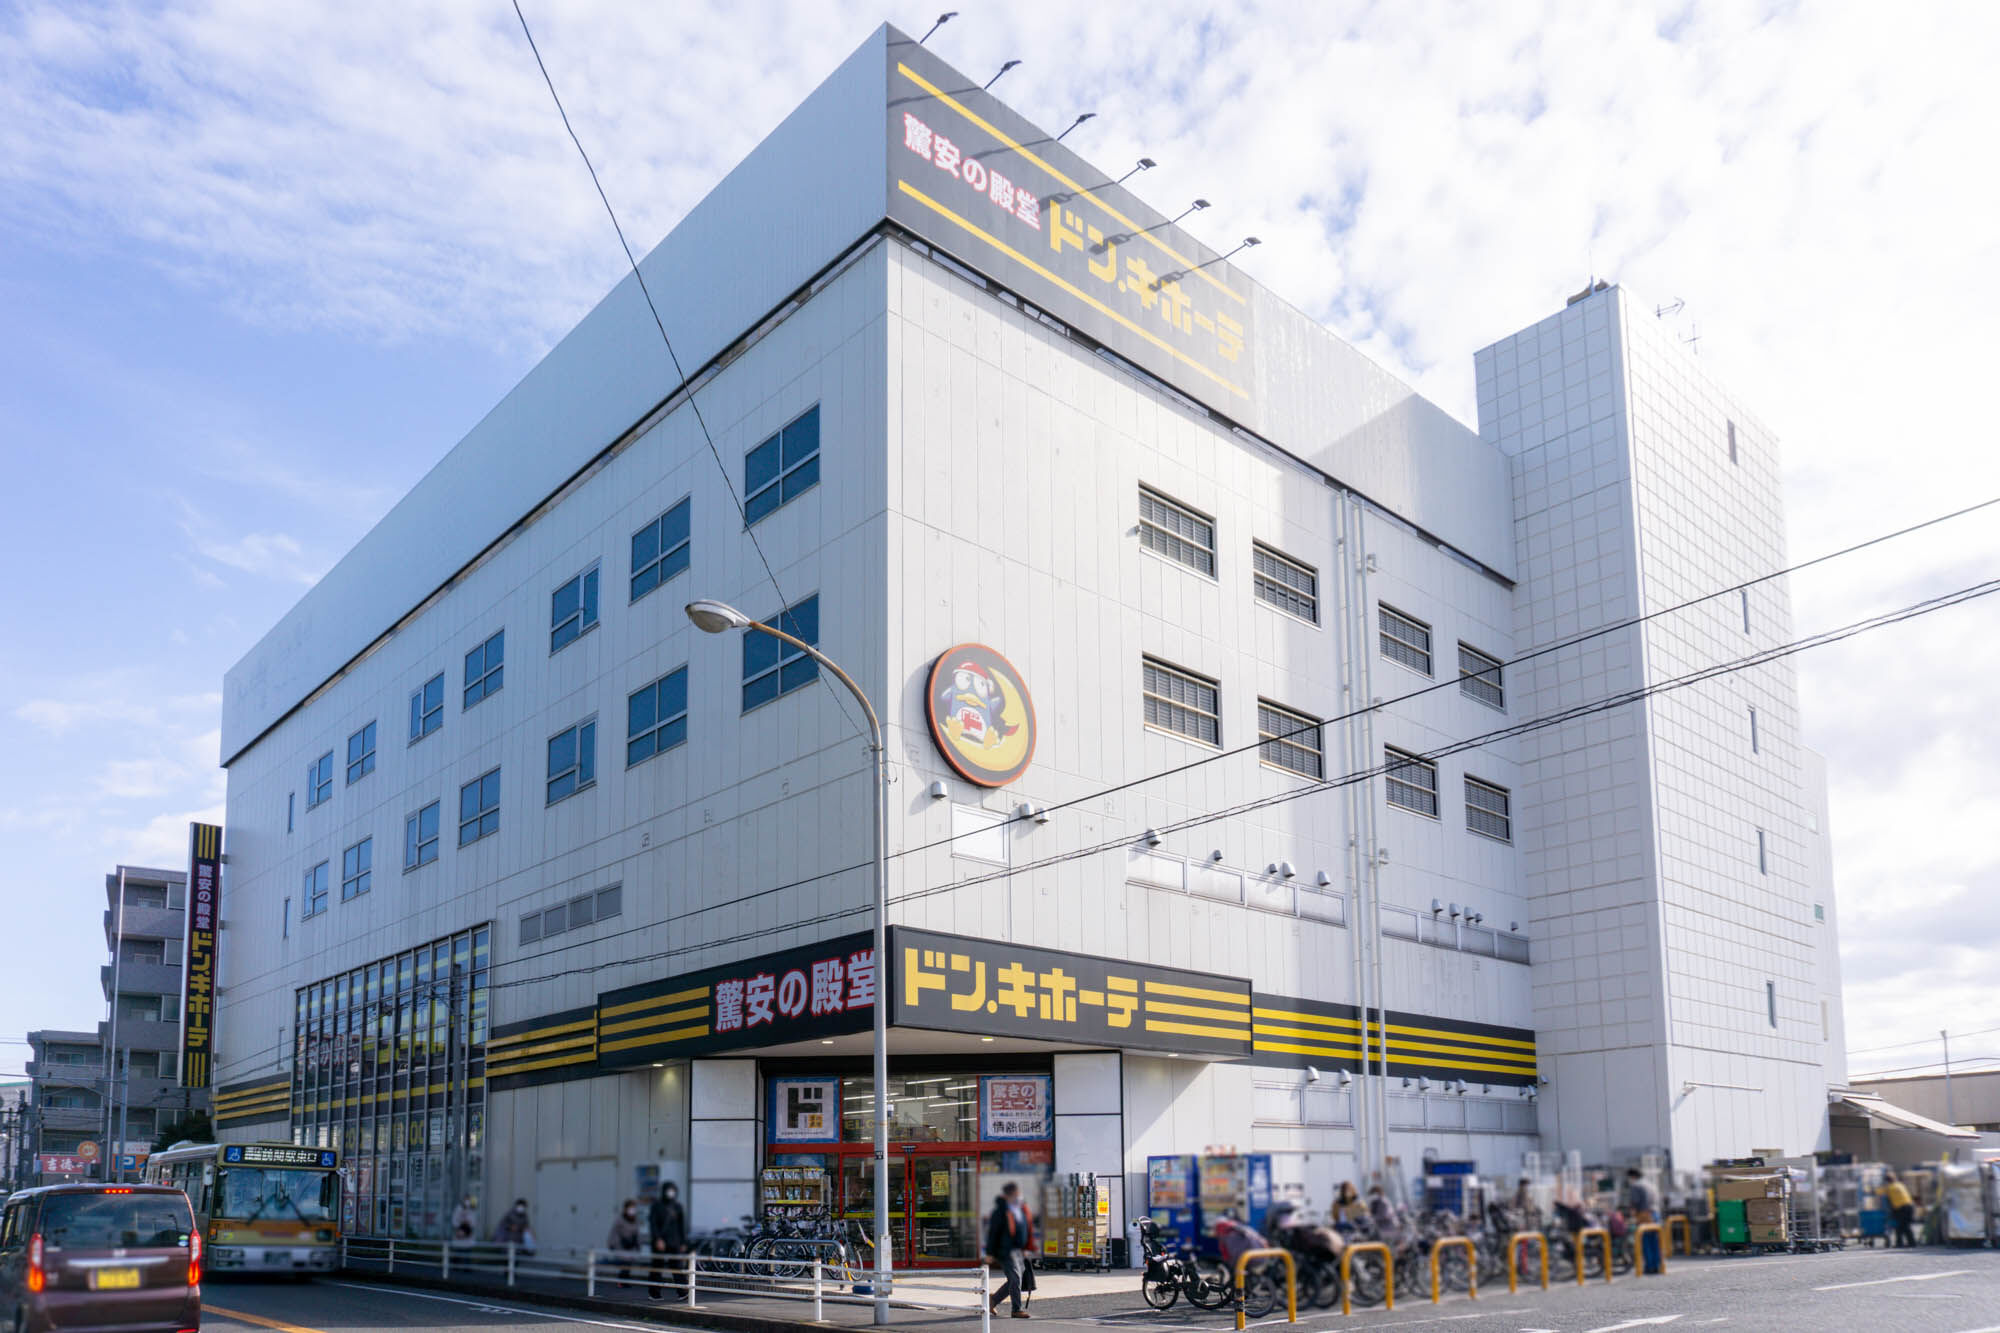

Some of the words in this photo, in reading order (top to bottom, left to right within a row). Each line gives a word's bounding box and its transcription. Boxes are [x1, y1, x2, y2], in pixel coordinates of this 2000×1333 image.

[903, 112, 1041, 231] 驚安の殿堂
[714, 947, 875, 1034] 驚安の殿堂
[992, 1120, 1042, 1134] 情熱価格
